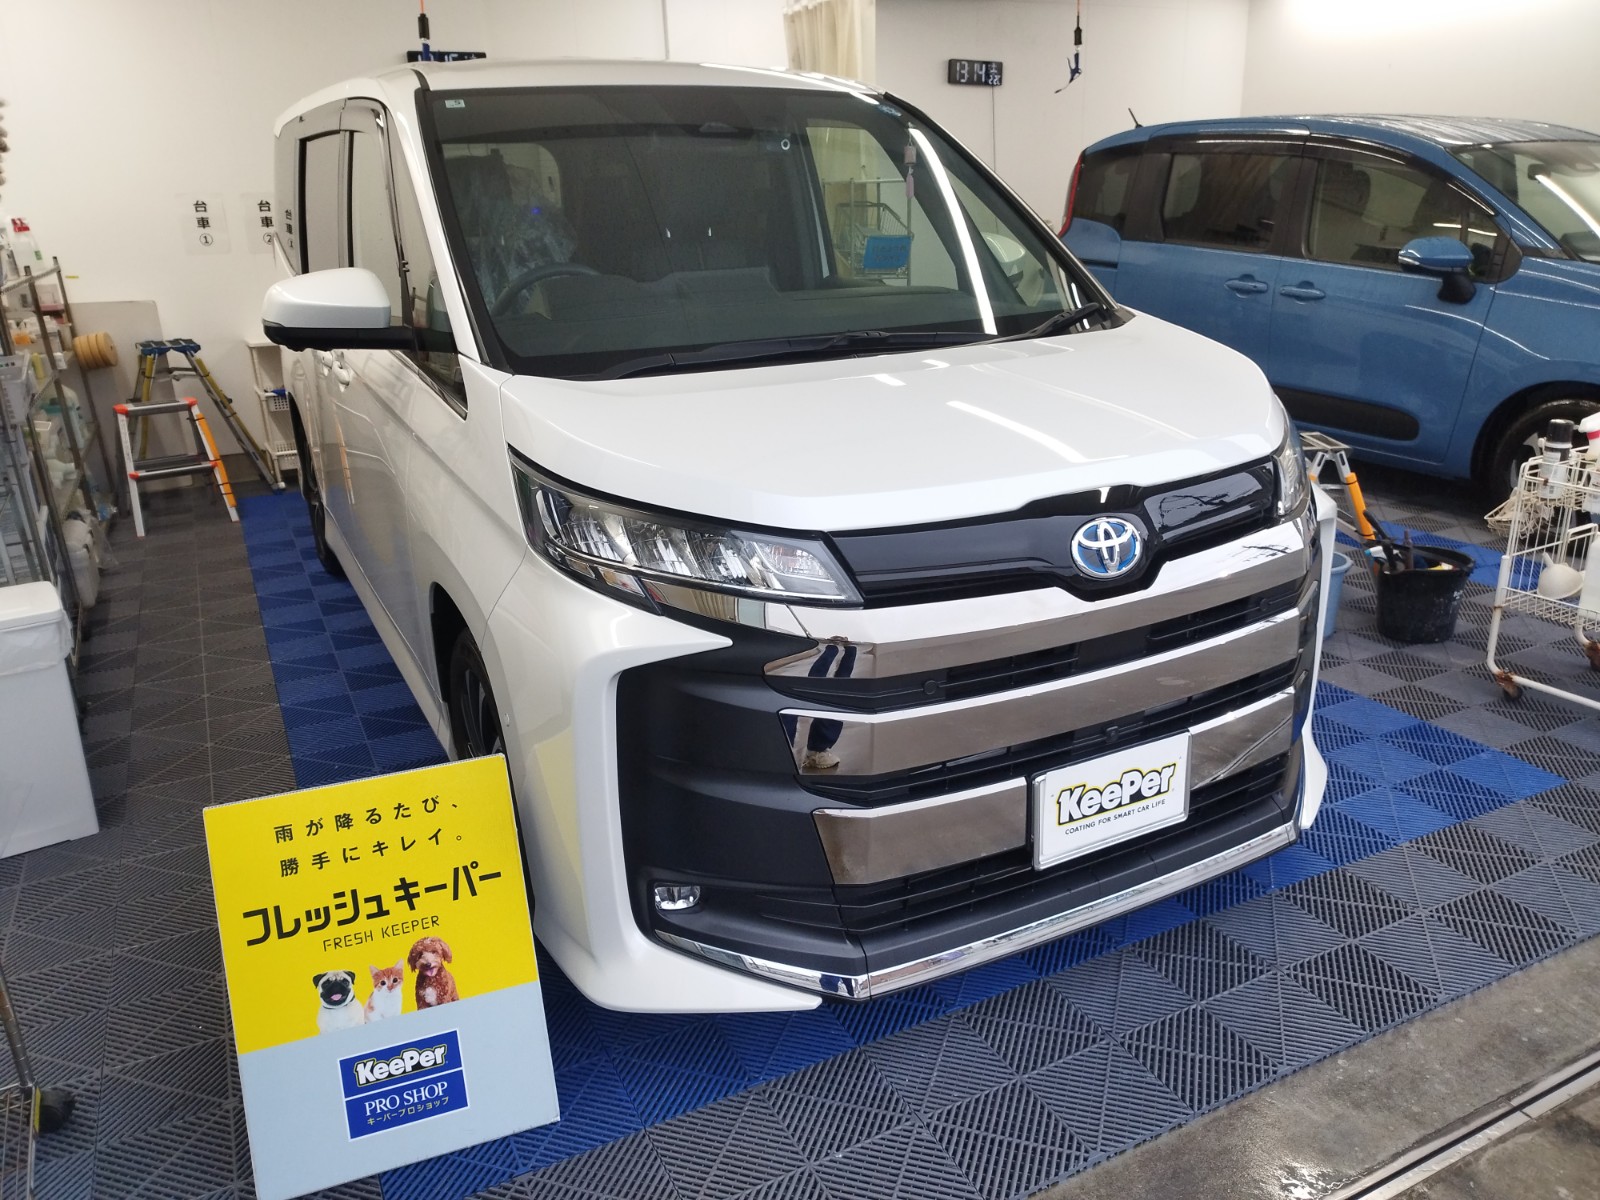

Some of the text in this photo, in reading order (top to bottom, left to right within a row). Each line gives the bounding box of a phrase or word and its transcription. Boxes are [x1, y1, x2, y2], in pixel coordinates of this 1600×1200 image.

[1057, 762, 1177, 827] KeePer
[273, 795, 458, 844] 雨が降るたび、
[1065, 798, 1166, 835] COATING FOR SMART CAR LIFE
[280, 827, 463, 878] 勝手にキレイ。
[242, 860, 502, 947] フレッシュキーパー
[323, 915, 440, 952] FRESH KEEPER
[354, 1045, 447, 1087] KeePer
[364, 1081, 448, 1117] PRO SHOP
[367, 1096, 449, 1126] キーパープロショップ
